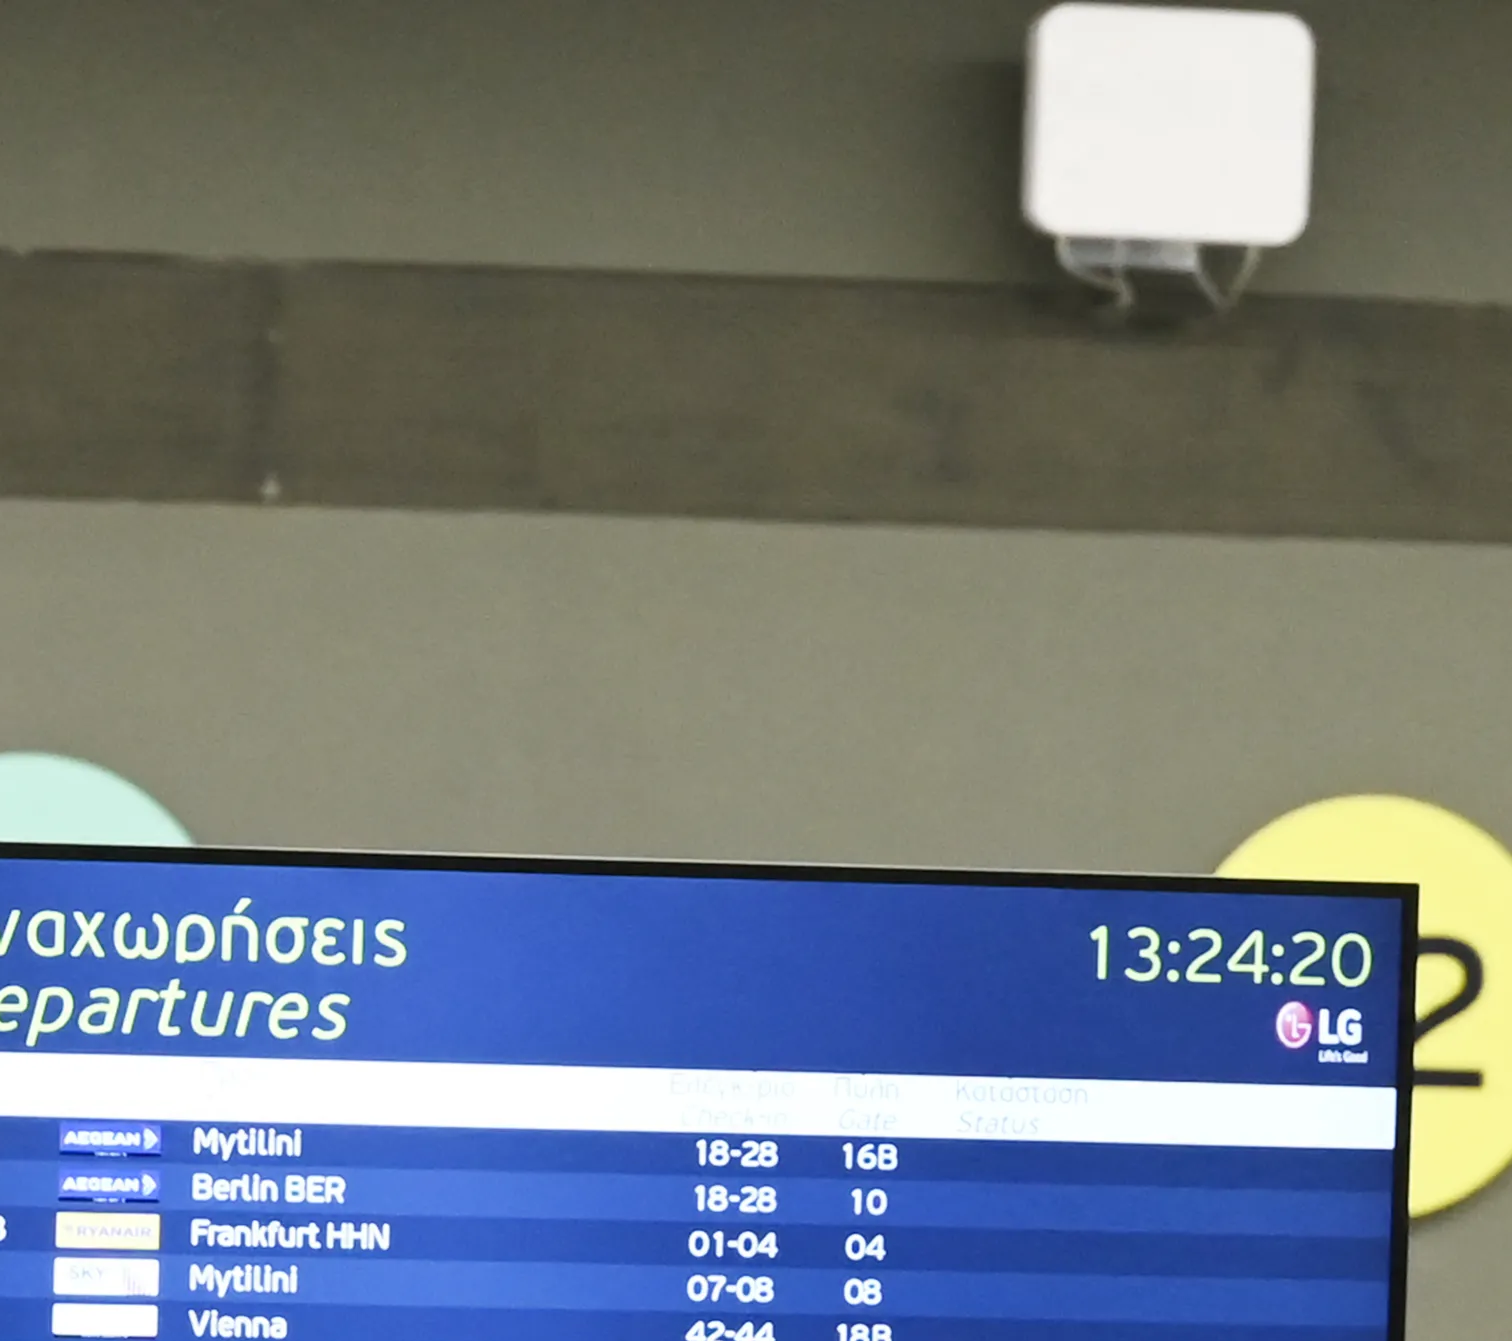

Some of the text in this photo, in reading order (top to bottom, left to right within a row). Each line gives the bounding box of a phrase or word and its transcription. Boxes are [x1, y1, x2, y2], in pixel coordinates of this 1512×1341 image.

[1090, 925, 1372, 988] 13:24:20
[1317, 1007, 1364, 1047] LG
[1413, 937, 1483, 1088] 2
[61, 1175, 140, 1194] AEGEAN
[191, 1172, 279, 1203] Berlin
[284, 1174, 347, 1204] BER
[694, 1184, 778, 1214] 18-28
[851, 1188, 888, 1216] 10
[190, 1218, 322, 1250] Frankfurt
[326, 1221, 391, 1251] HHN
[688, 1230, 779, 1259] 01-04
[844, 1233, 887, 1261] 04
